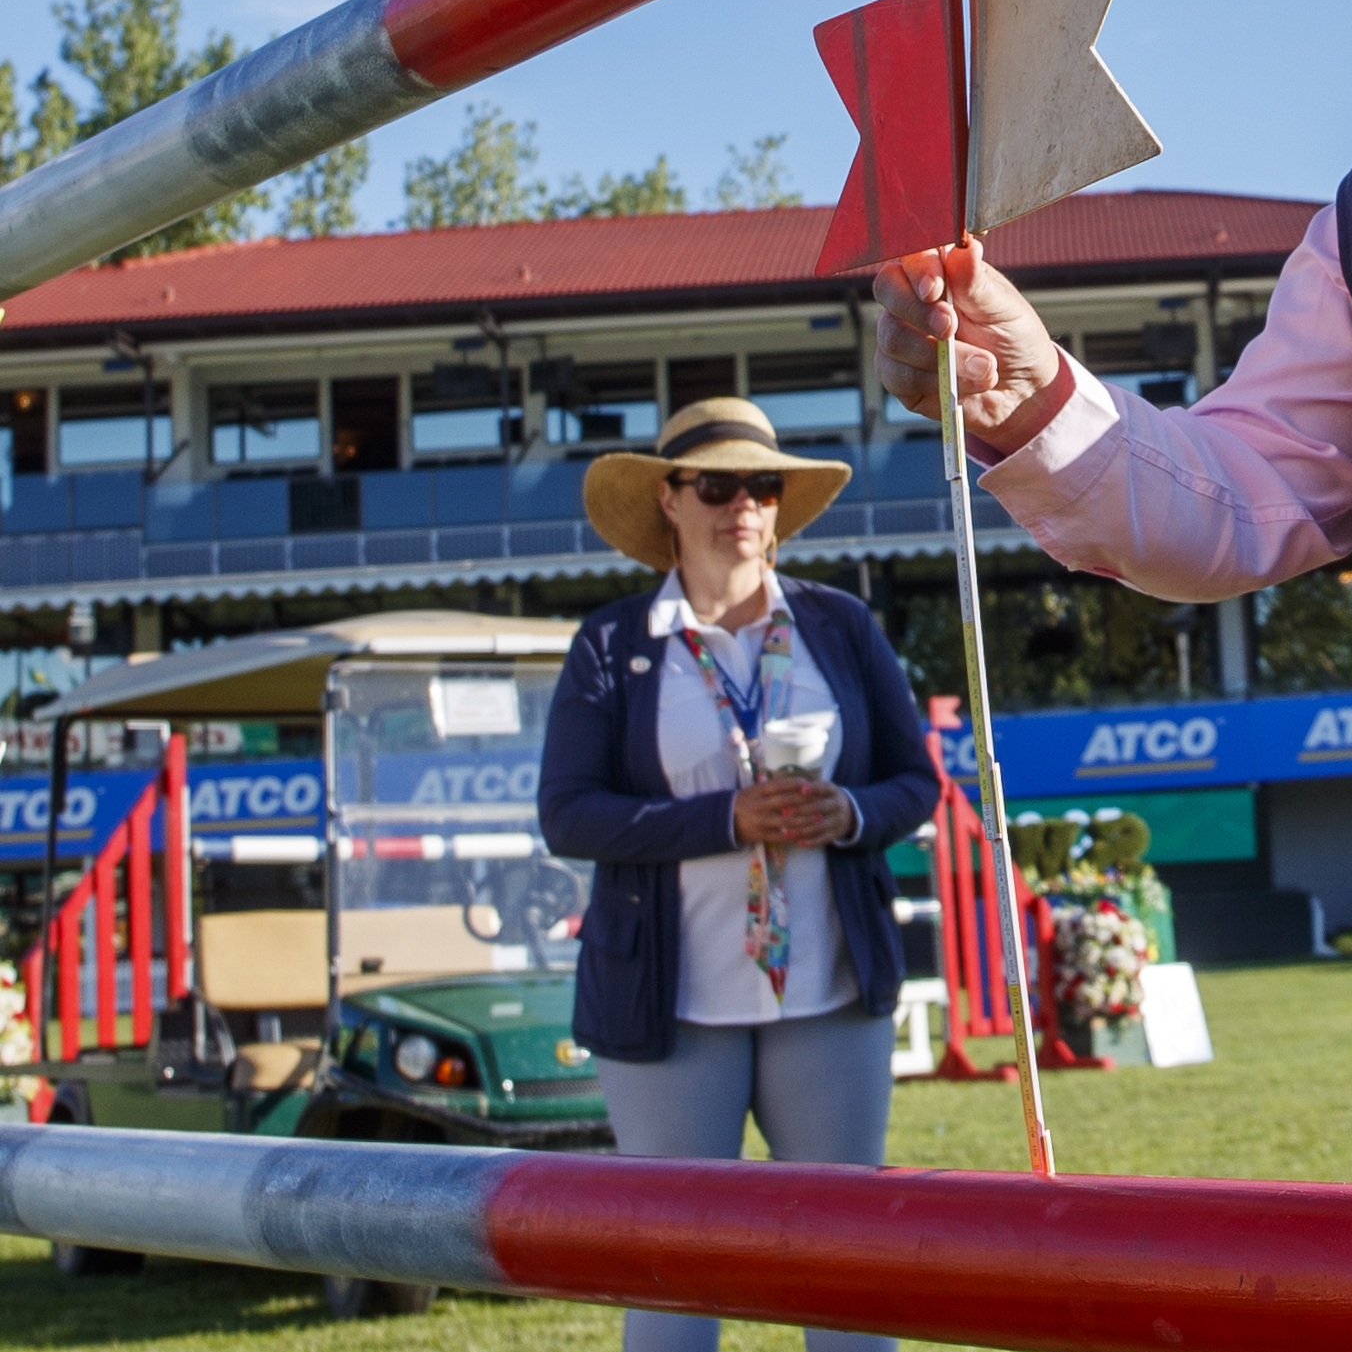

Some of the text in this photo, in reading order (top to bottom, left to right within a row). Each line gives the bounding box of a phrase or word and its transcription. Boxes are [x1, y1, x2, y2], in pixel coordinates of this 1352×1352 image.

[1080, 716, 1218, 765] ATCO
[190, 774, 321, 819] ATCO
[410, 763, 540, 805] ATCO
[0, 785, 98, 830] TCO
